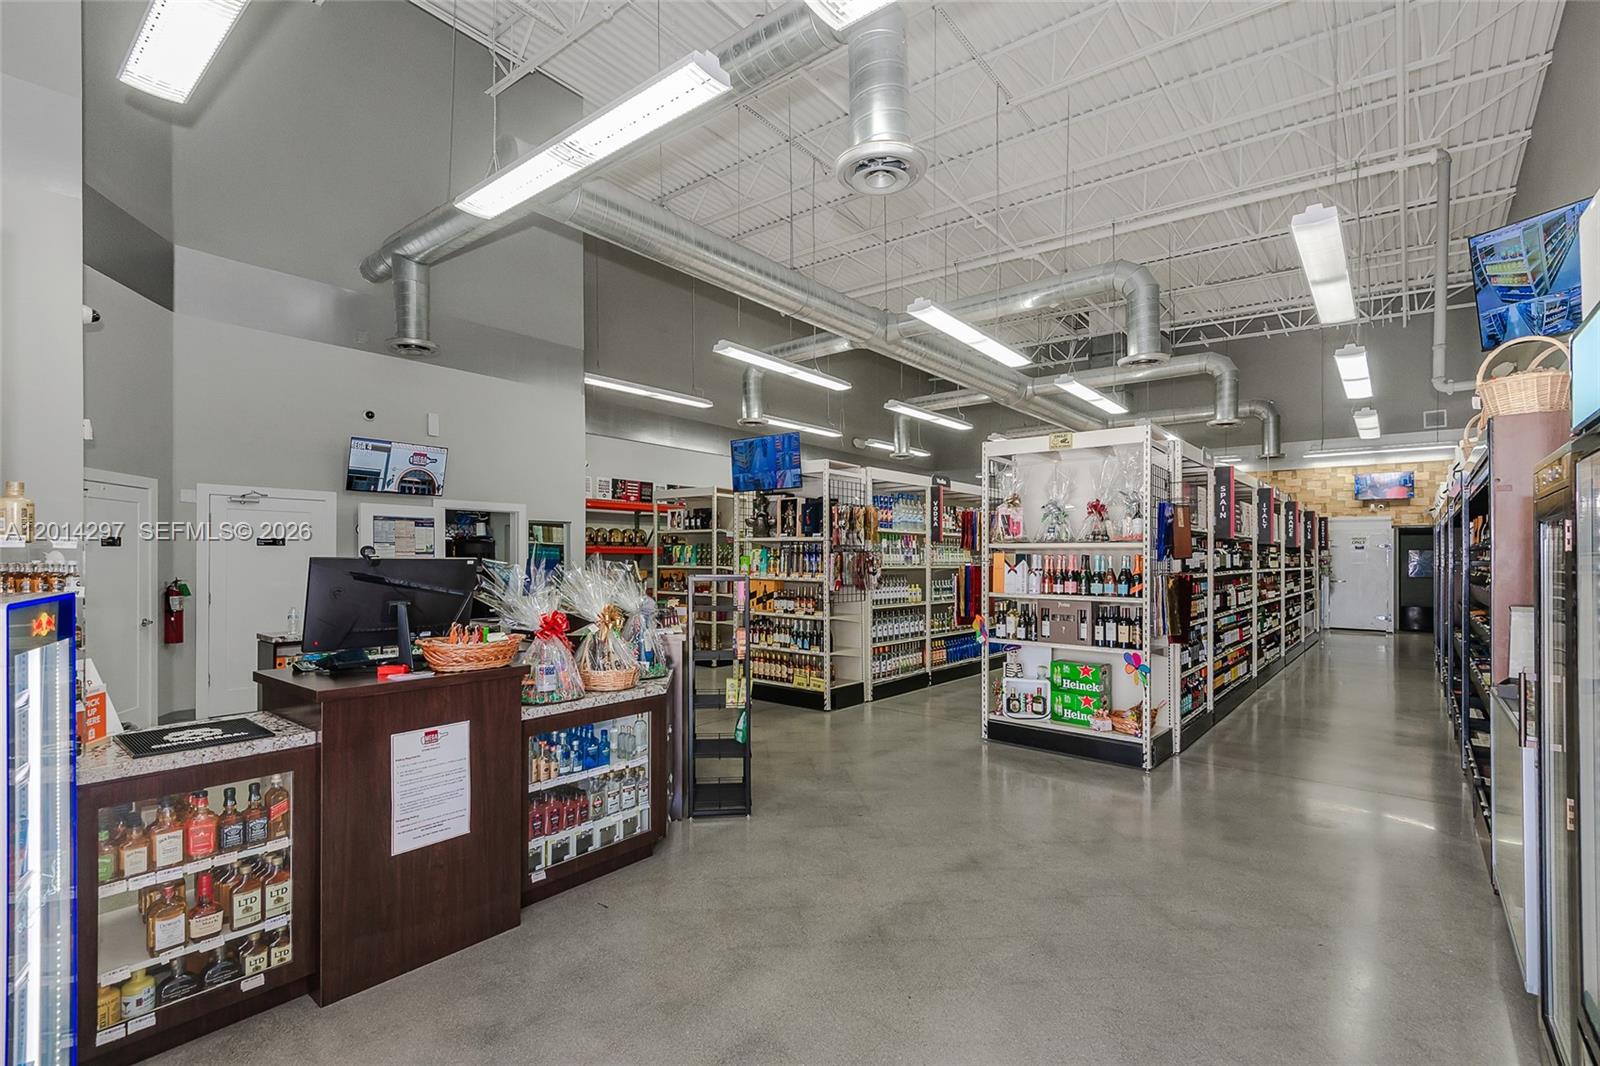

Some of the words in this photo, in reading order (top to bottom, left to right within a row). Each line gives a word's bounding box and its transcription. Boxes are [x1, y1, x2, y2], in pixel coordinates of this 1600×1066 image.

[1219, 485, 1227, 519] SPAIN
[87, 707, 97, 717] UP
[270, 887, 288, 898] LTD
[238, 896, 258, 908] LTD
[274, 949, 290, 959] LTD
[249, 957, 265, 967] LTD
